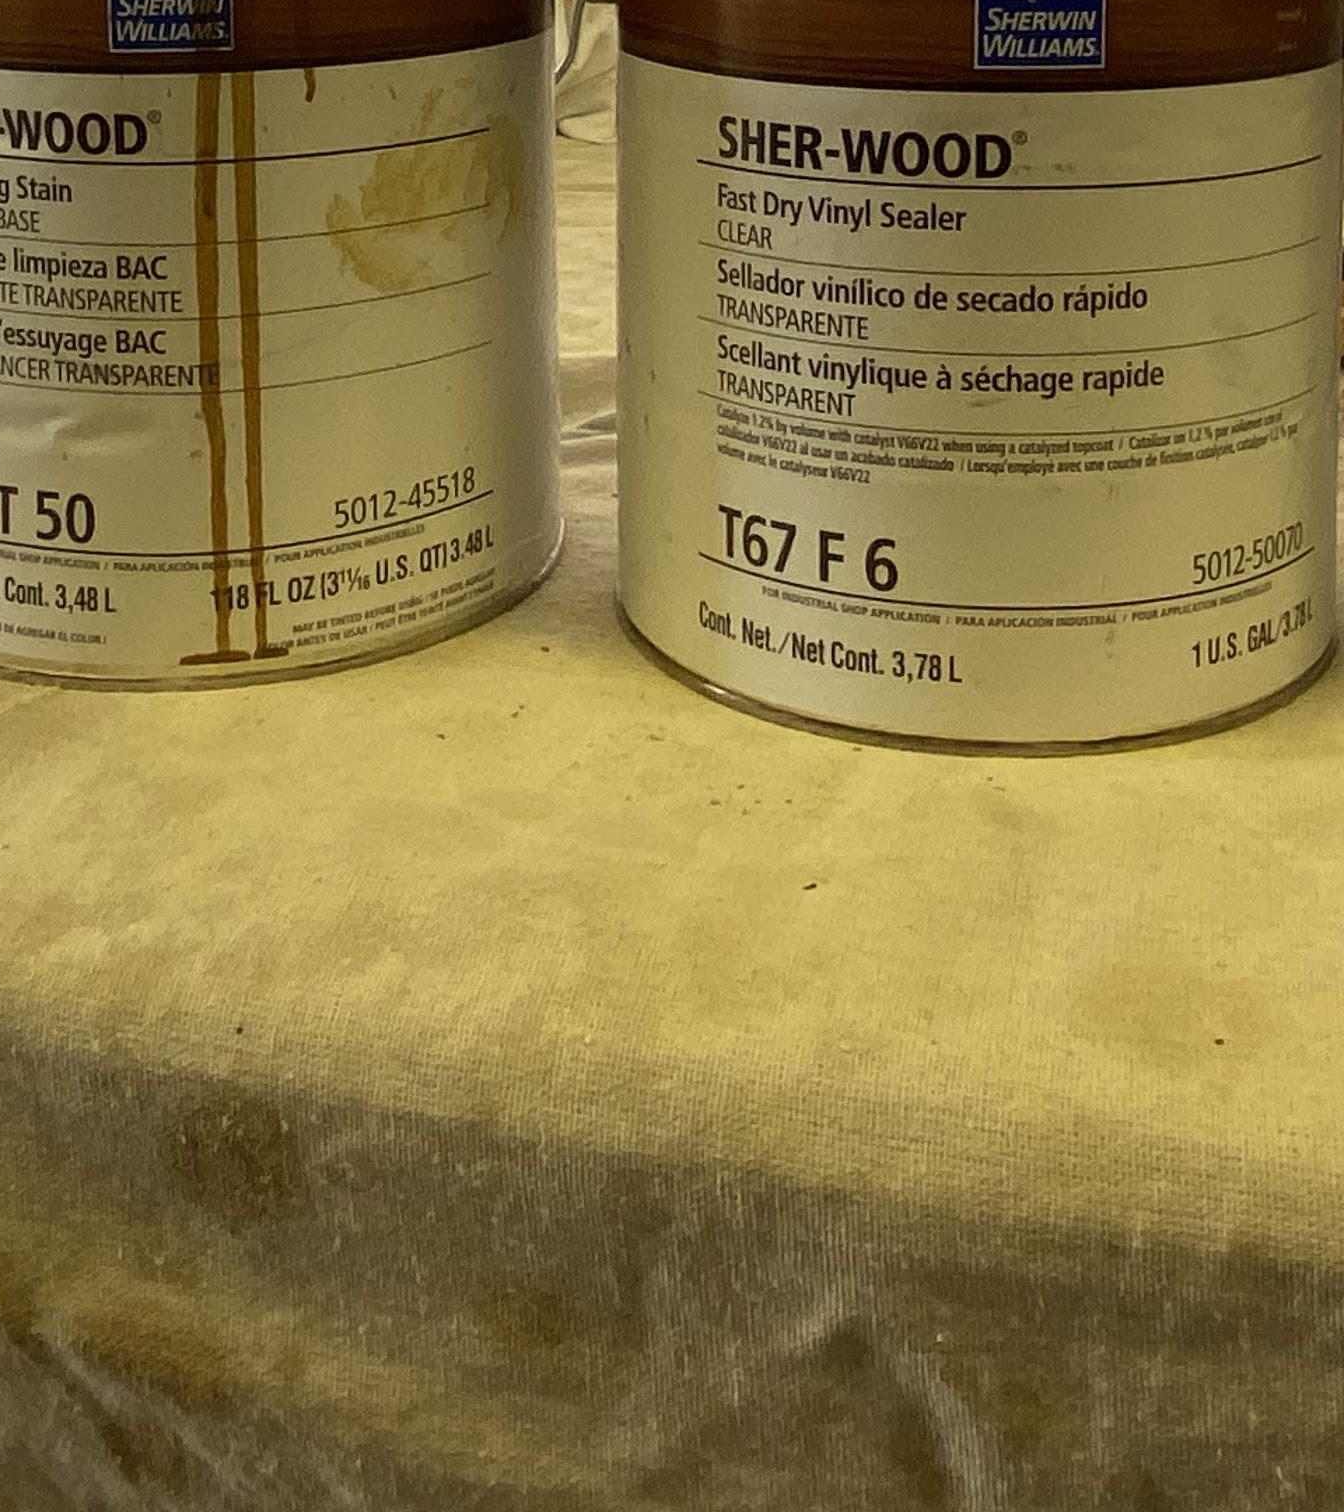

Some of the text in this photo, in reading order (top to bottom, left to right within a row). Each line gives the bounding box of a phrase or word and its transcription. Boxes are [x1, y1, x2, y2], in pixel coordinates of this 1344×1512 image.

[116, 20, 226, 41] WILLIAMS
[984, 7, 1096, 31] SHERWIN
[983, 34, 1098, 58] WILLIAMS
[16, 175, 72, 202] Stain
[718, 183, 967, 232] Fast Dry Vinyl Sealer
[717, 219, 773, 250] CLEAR
[14, 247, 107, 283] limpieza
[116, 255, 168, 281] BAC
[717, 258, 1147, 318] Sellador vinílico de secado rápido
[22, 282, 183, 314] TRANSPARENTE
[717, 293, 869, 341] TRANSPARENTE
[115, 329, 167, 355] BAC
[717, 334, 1164, 399] Scellant vinylique à séchage rapide
[717, 368, 856, 417] TRANSPARENT
[36, 490, 95, 544] 50
[335, 466, 475, 529] 5012-45518
[718, 503, 898, 592] T67 F 6
[1193, 521, 1303, 585] 5012-50070
[5, 575, 49, 609] Cont.
[56, 584, 98, 615] 3,48
[104, 586, 116, 613] L
[288, 553, 414, 605] OZ U.S.
[699, 600, 736, 640] Cont.
[831, 641, 885, 675] Cont.
[892, 650, 942, 684] 3,78
[949, 655, 962, 683] L
[1208, 632, 1243, 665] U.S.
